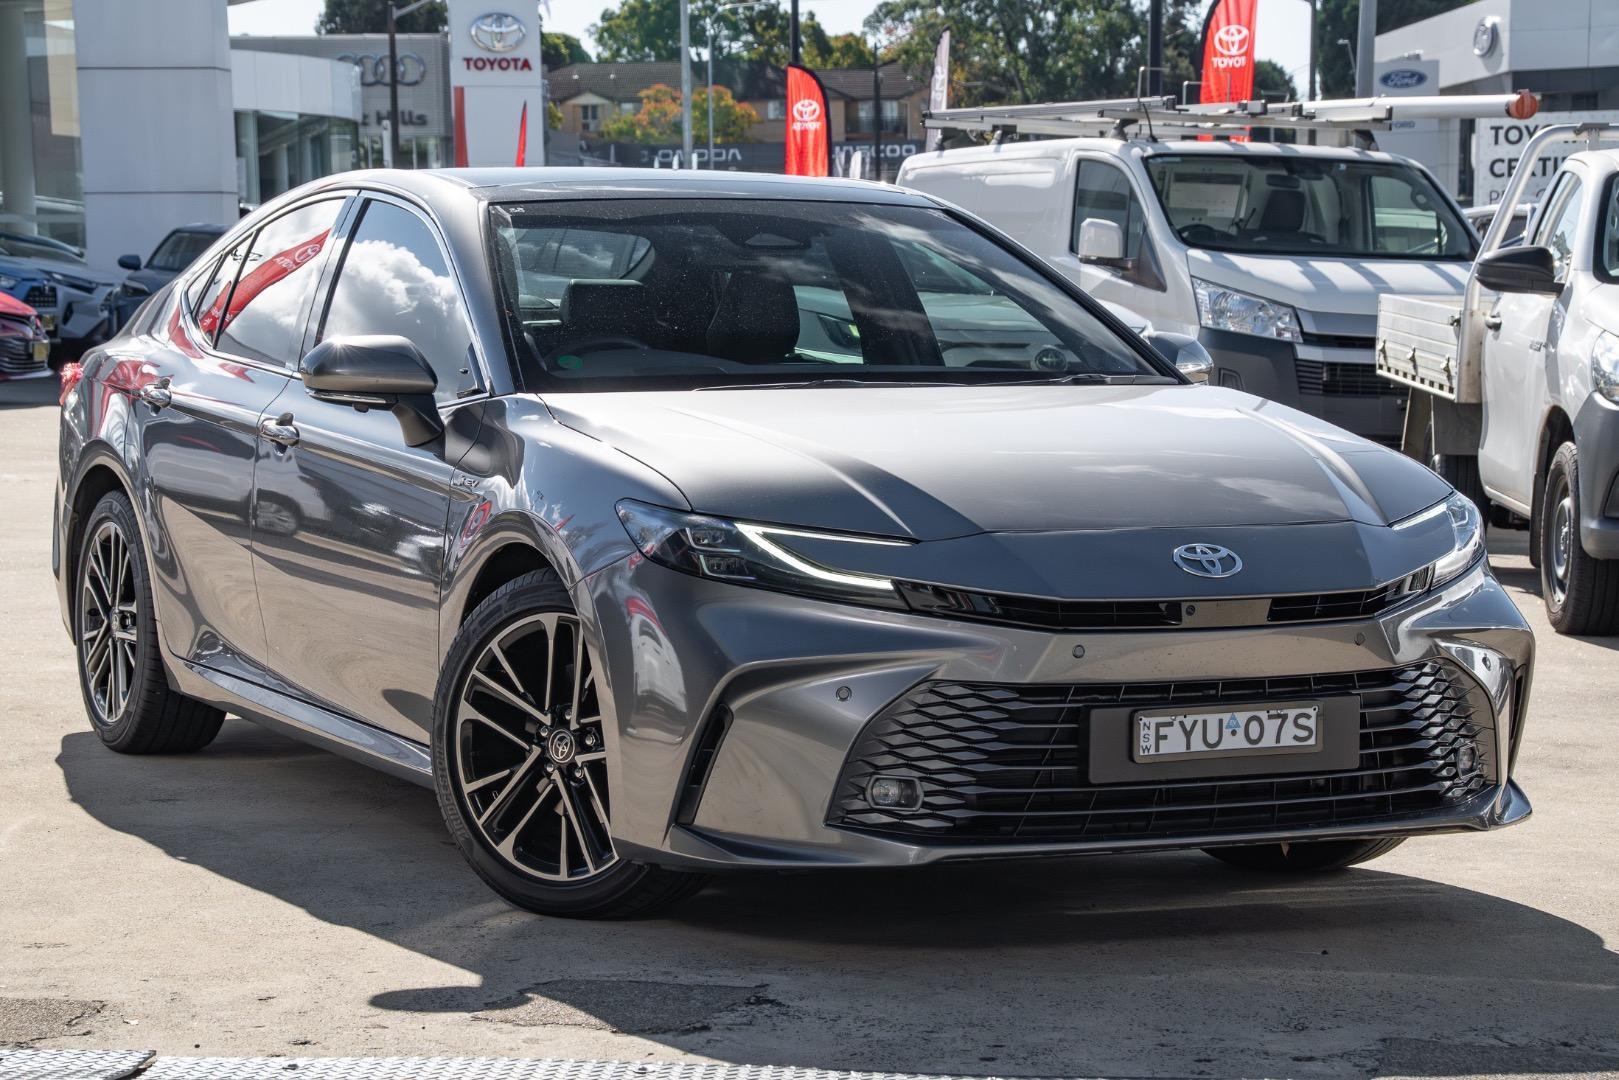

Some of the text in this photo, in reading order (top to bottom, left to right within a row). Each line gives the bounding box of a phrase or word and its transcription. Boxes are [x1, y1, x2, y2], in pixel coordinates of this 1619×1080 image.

[462, 57, 533, 71] TOYOTA
[1211, 56, 1247, 69] TOYOT
[375, 110, 428, 126] Hlls
[1490, 124, 1578, 146] TOY
[1489, 156, 1568, 178] CETI
[1141, 721, 1153, 754] NSW
